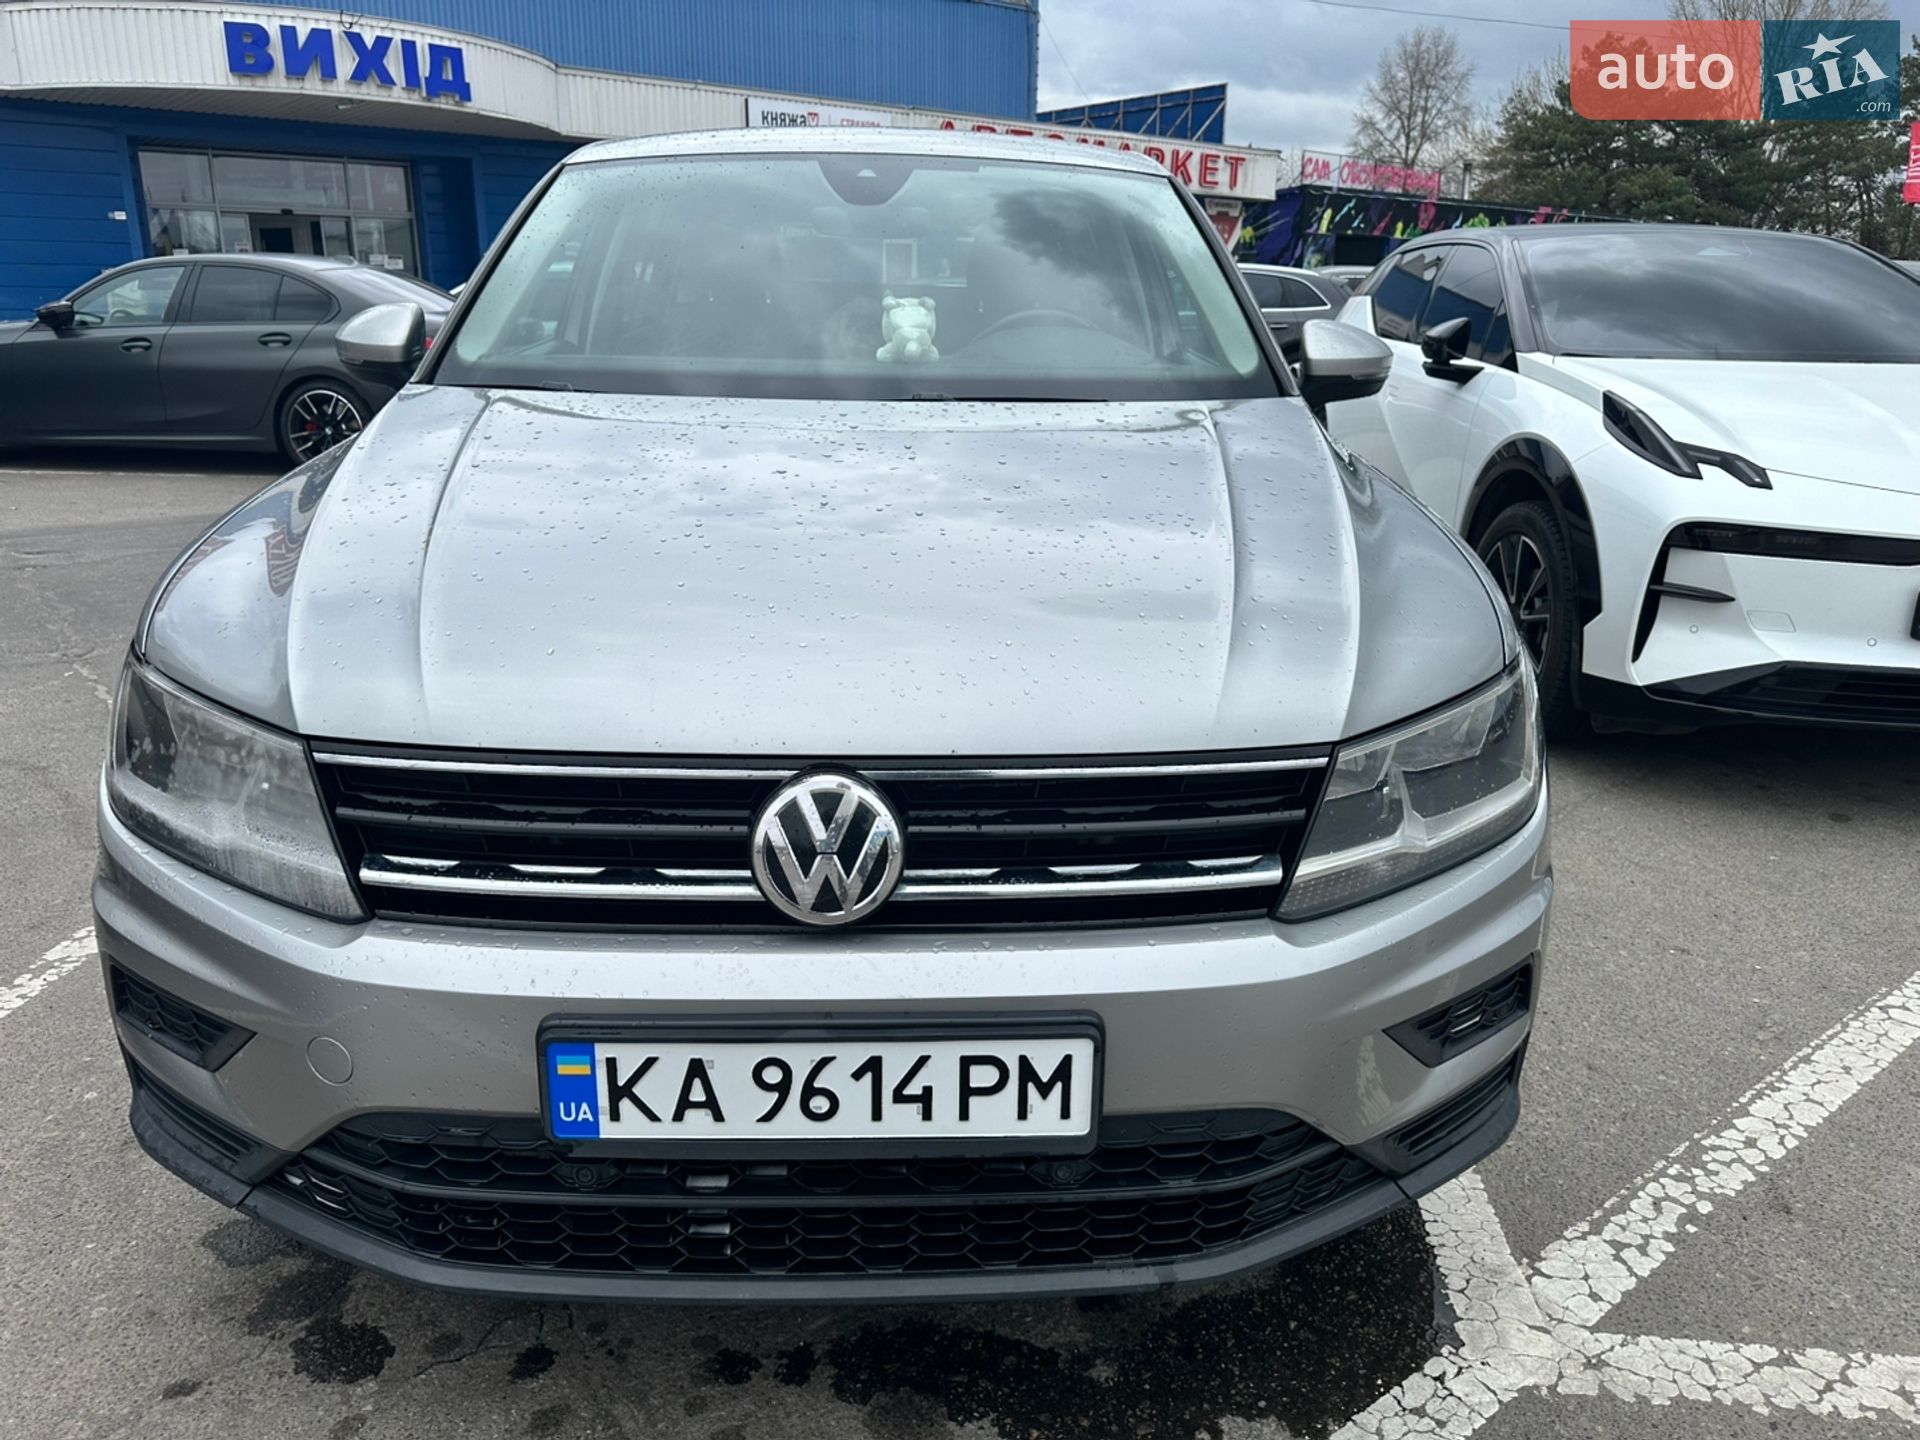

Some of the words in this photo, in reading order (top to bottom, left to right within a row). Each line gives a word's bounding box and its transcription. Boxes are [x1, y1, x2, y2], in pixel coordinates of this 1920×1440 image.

[223, 21, 472, 102] ВИХІД
[559, 1101, 594, 1122] UA
[605, 1056, 725, 1122] KA
[752, 1055, 933, 1122] 9614
[958, 1054, 1073, 1121] PM
